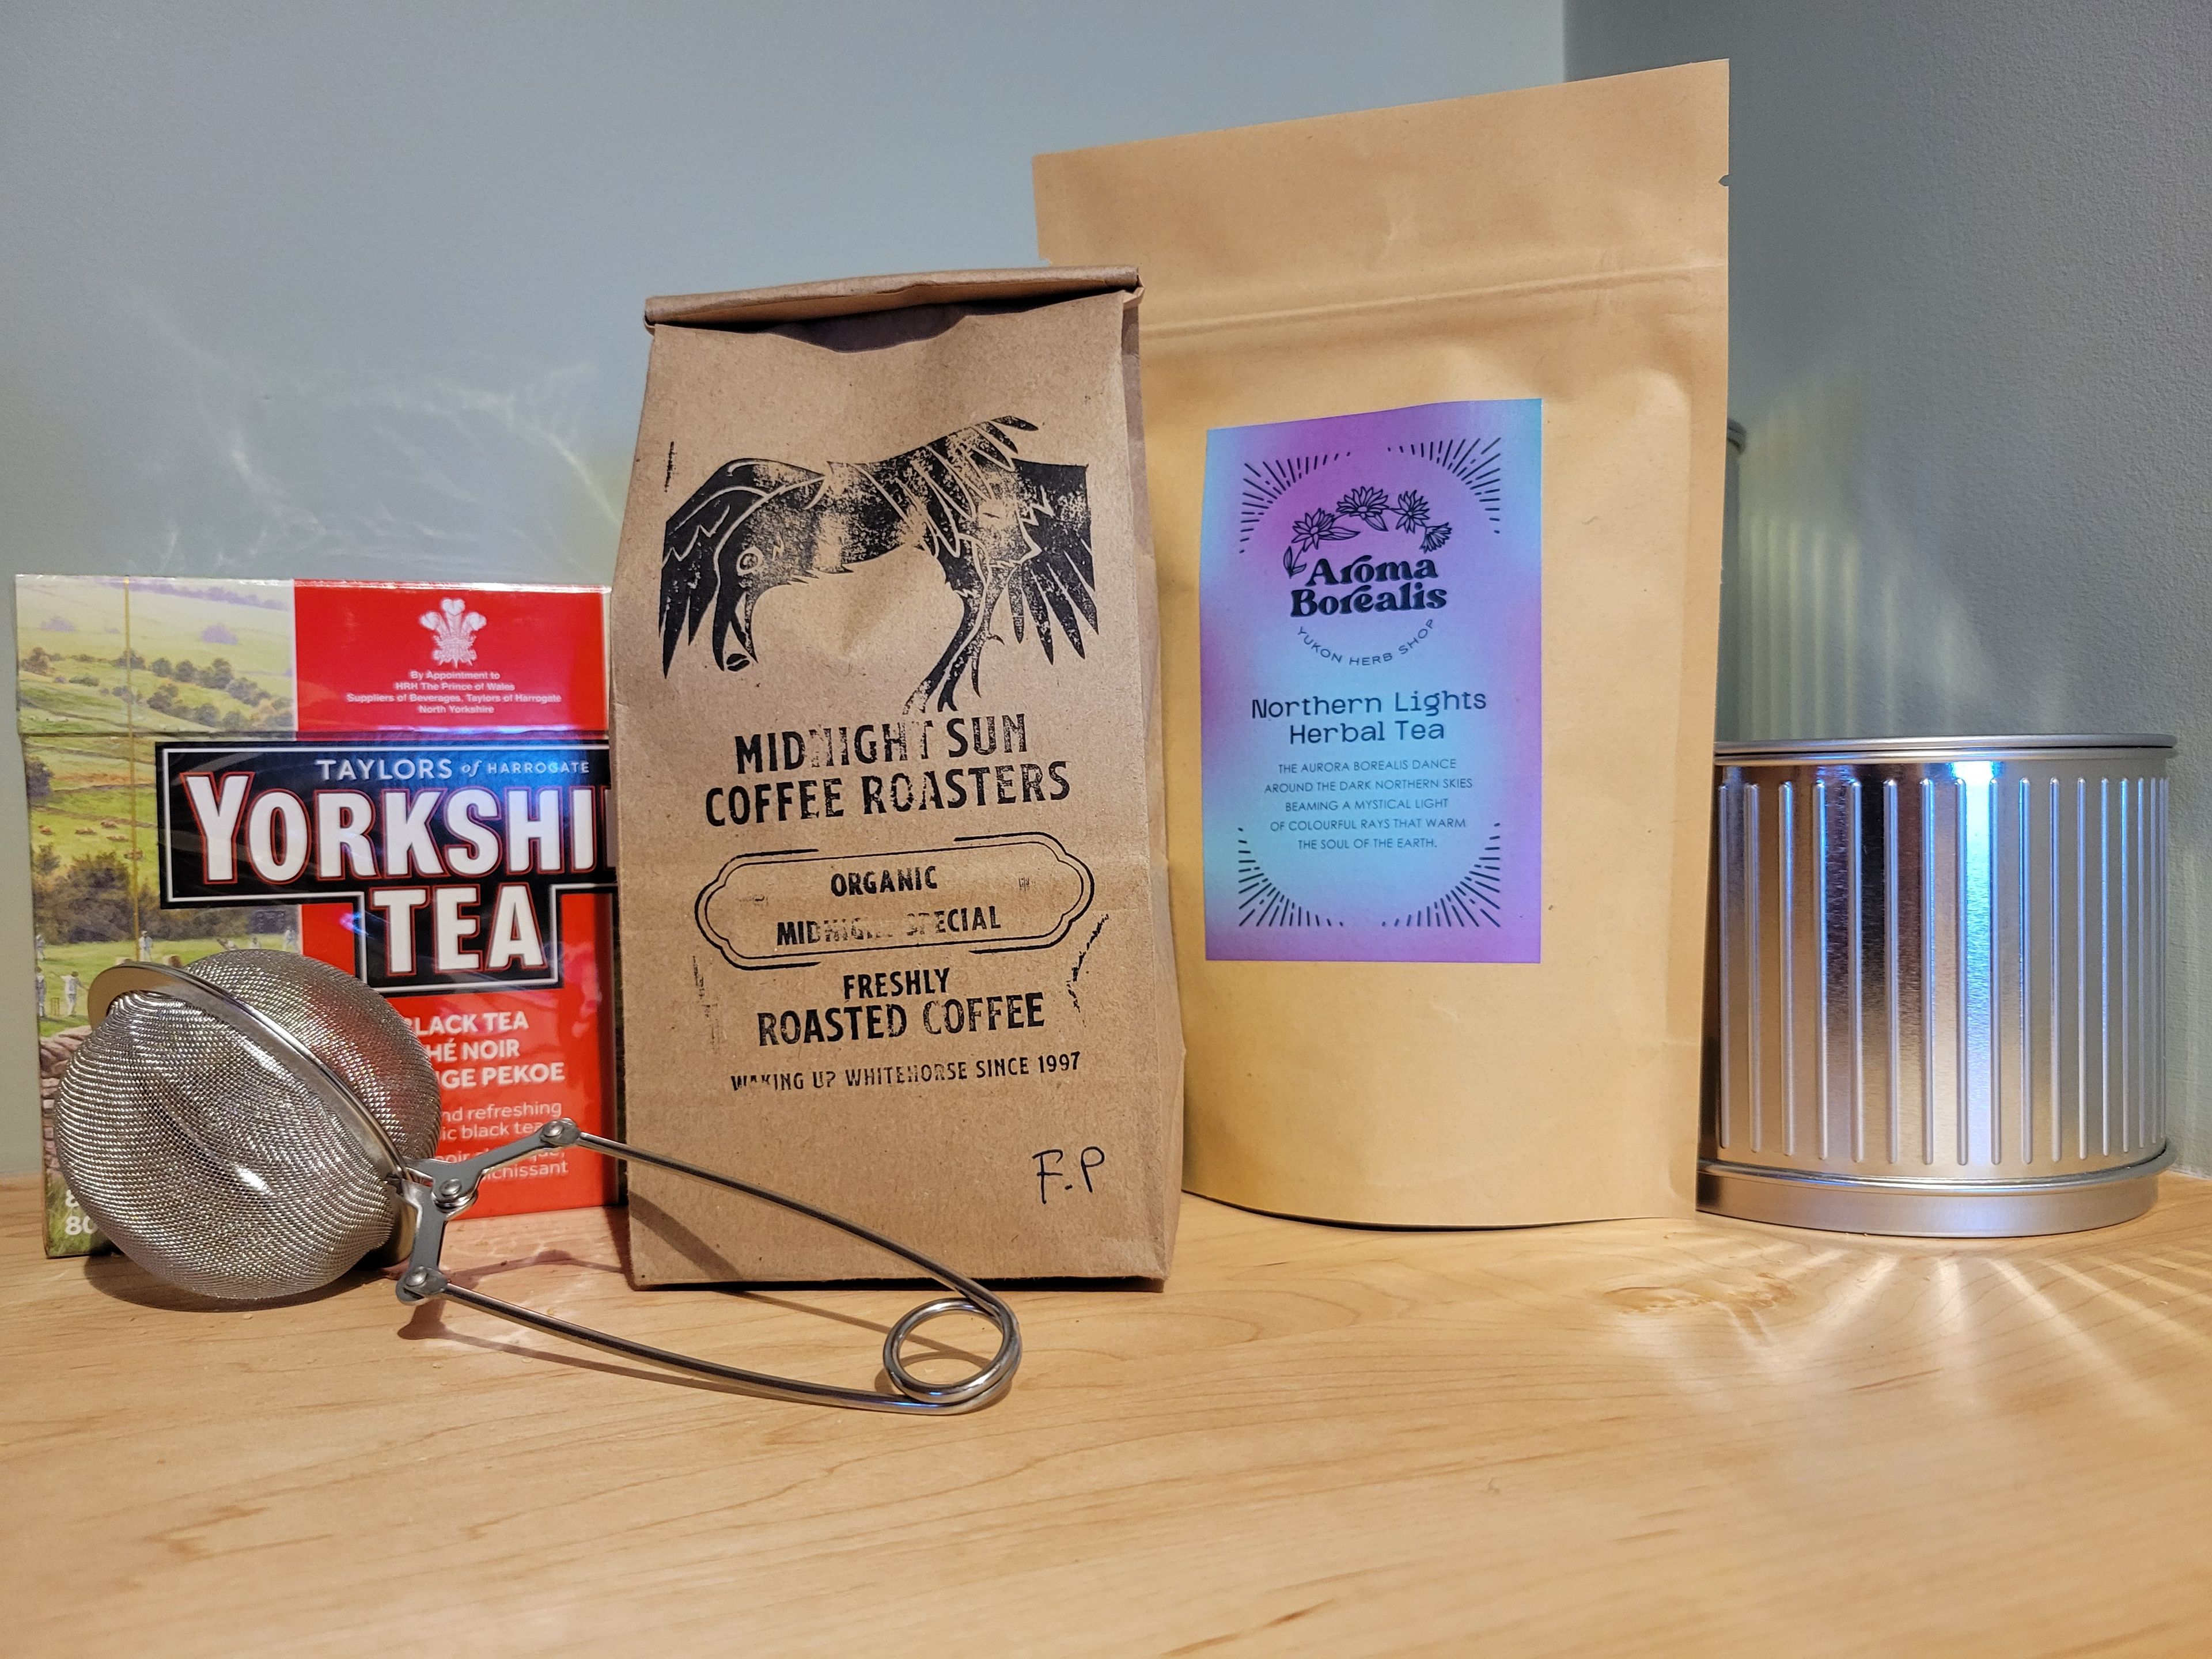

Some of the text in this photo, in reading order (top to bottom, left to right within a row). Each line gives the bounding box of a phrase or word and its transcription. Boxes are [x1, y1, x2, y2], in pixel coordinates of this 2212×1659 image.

[1305, 555, 1438, 587] Aroma
[1291, 582, 1447, 617] Borealis
[1297, 619, 1433, 666] YUKON HERB SHOP
[395, 681, 516, 691] HRH The Prince of Wales
[410, 671, 501, 681] By Appointment to
[346, 692, 395, 703] Suppliers
[396, 694, 407, 702] of
[465, 694, 502, 703] Taylors
[502, 694, 513, 702] of
[514, 694, 562, 704] Harrogate
[418, 704, 494, 714] North Yorkshire
[1252, 690, 1487, 719] Northern Lights
[946, 714, 1027, 757] SUN
[1290, 720, 1444, 745] Herbal Tea
[315, 758, 589, 781] TAYLORS of HARROGATE
[1278, 758, 1456, 774] THE AURORA BOREALIS DANCE
[706, 761, 1070, 827] COFFEE ROASTERS
[1264, 778, 1473, 794] AROUND THE DARK NORTHERN SKIES
[1285, 798, 1449, 812] BEAMING A MYSTICAL LIGHT
[1270, 817, 1466, 832] OF COLOURFUL RAYS THAT WARM
[1298, 838, 1437, 850] THE SOUL OF THE EARTH.
[831, 865, 938, 897] ORGANIC
[369, 884, 550, 976] TEA
[843, 968, 951, 1000] FRESHLY
[482, 1011, 529, 1032] TEA
[757, 992, 1044, 1047] ROASTED COFFEE
[425, 1037, 520, 1063] HÉ NOIR
[481, 1062, 565, 1086] PEKOE
[845, 1061, 968, 1086] WHITEHORSE
[976, 1056, 1029, 1078] SINCE
[1037, 1051, 1081, 1073] 1997
[441, 1101, 562, 1122] nd refreshing
[461, 1122, 510, 1139] black
